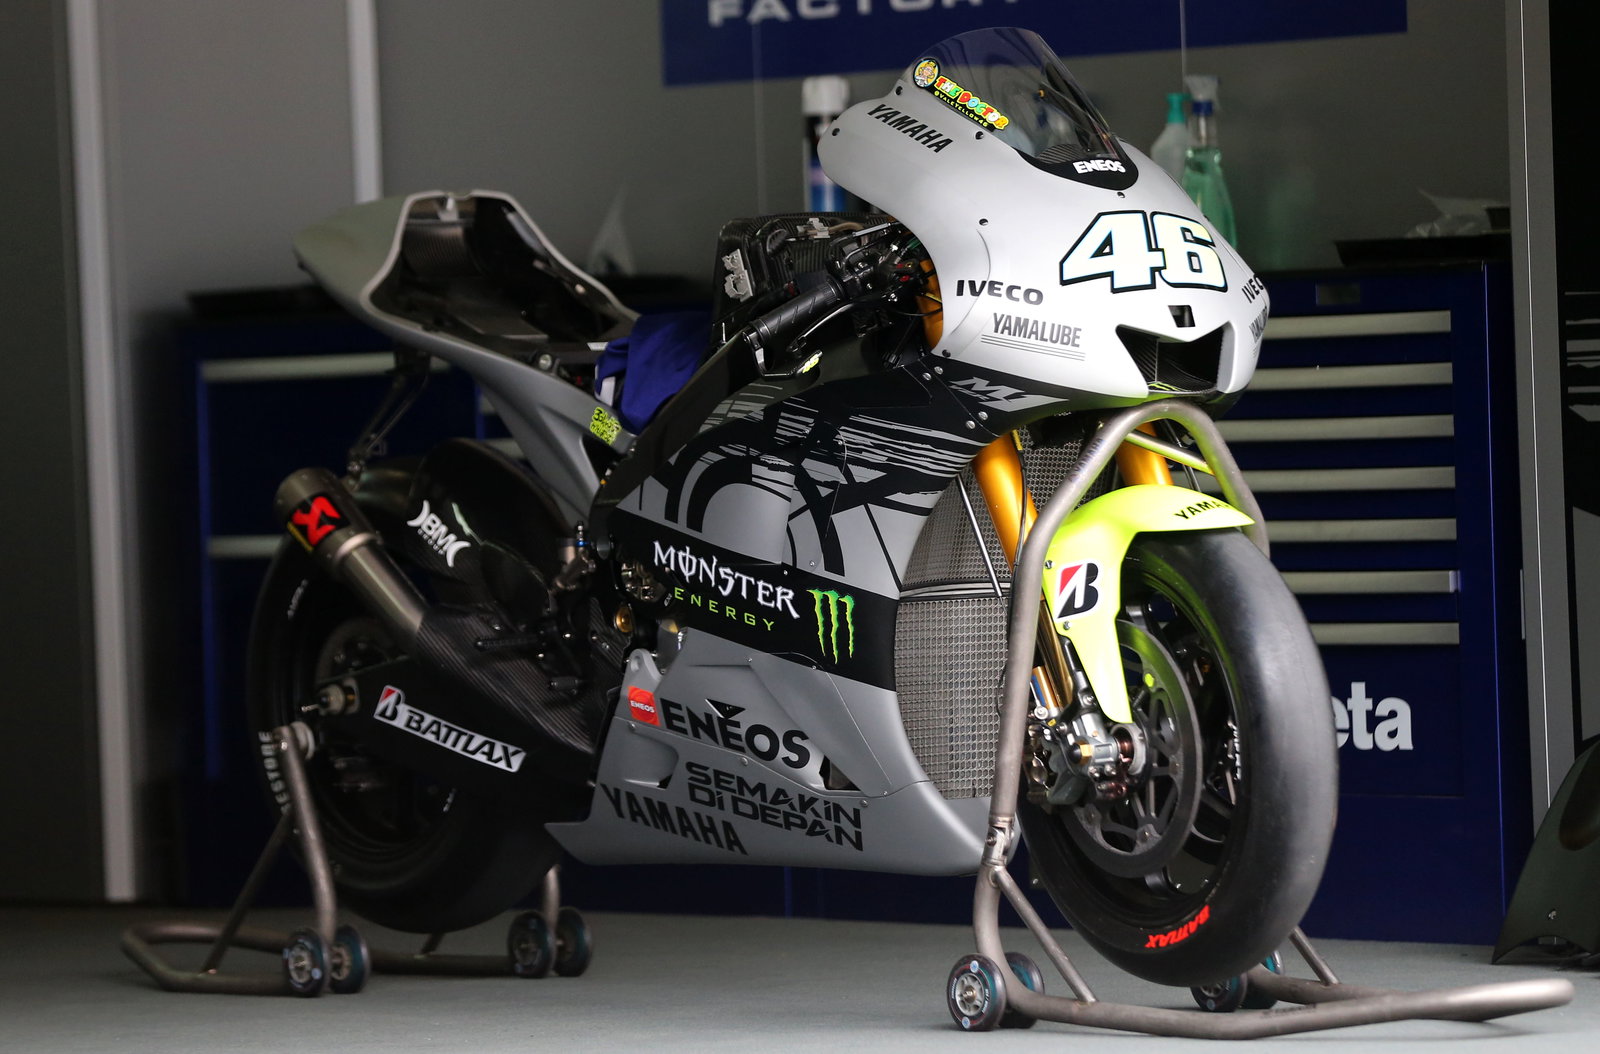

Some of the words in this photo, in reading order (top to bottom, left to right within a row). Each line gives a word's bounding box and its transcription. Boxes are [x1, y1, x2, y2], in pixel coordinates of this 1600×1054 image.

[934, 76, 964, 99] THE
[957, 91, 1009, 130] DOCTOR
[867, 104, 953, 153] YAMAHA
[1072, 159, 1126, 174] ENEOS
[1059, 210, 1228, 294] 46
[956, 279, 1044, 305] IVECO
[1241, 273, 1265, 304] IVEC
[993, 312, 1082, 348] YAMALUBE
[1174, 500, 1230, 520] YAMA
[653, 540, 800, 619] MONSTER
[674, 587, 774, 631] ENERGY
[631, 700, 655, 714] ENEOS
[404, 709, 523, 769] BATTLAX
[660, 698, 811, 769] ENEOS
[600, 783, 748, 855] YAMAHA
[732, 797, 864, 852] DEPAN
